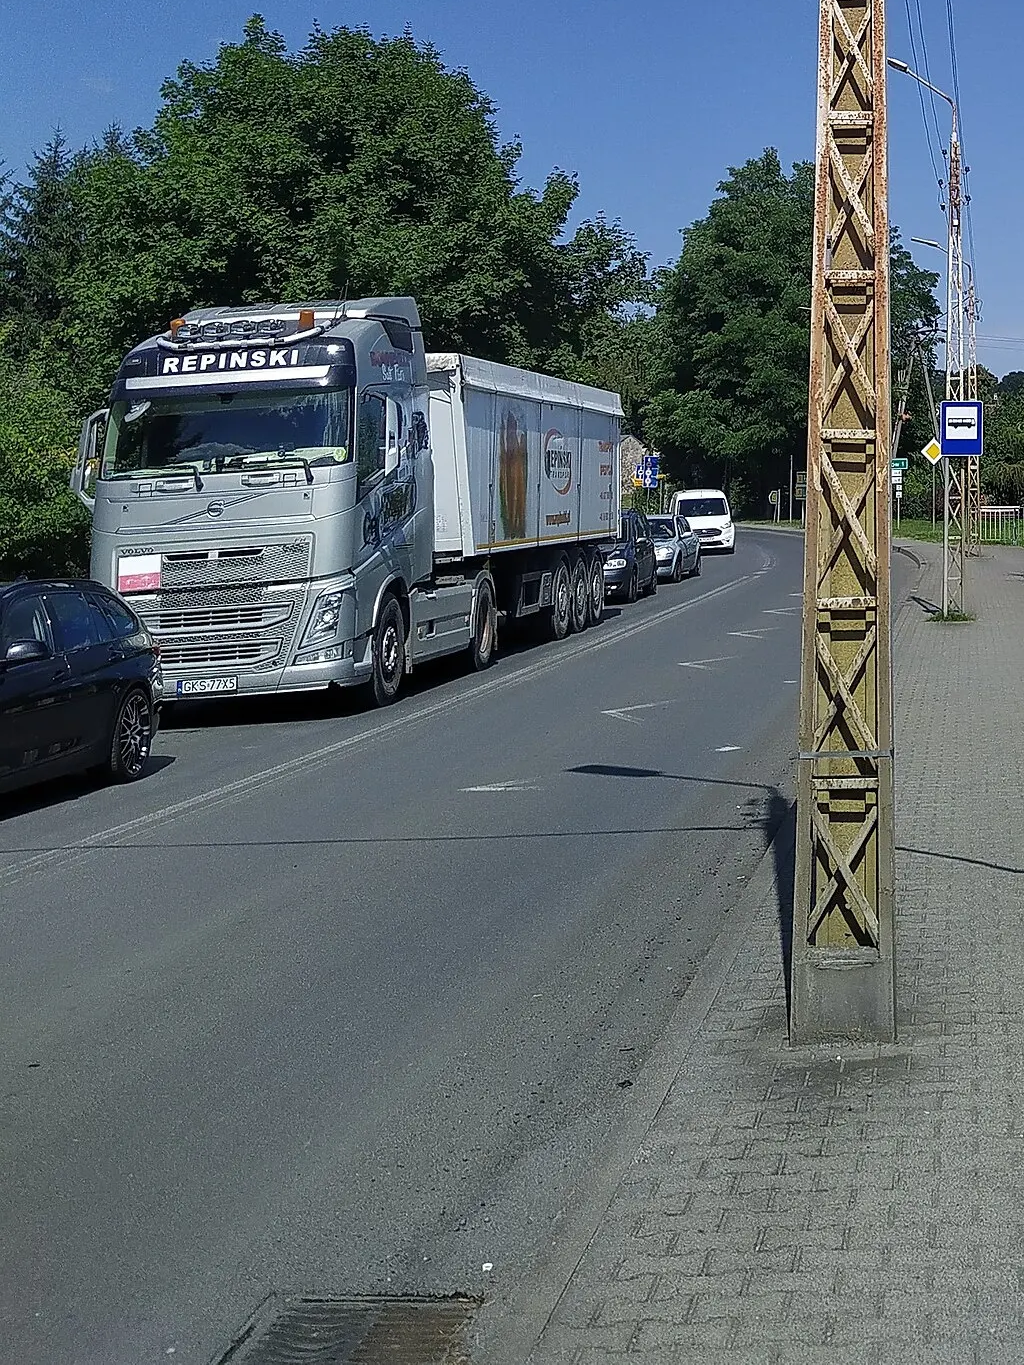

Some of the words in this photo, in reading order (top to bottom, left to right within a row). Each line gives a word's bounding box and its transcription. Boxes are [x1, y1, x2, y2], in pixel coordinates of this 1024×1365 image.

[162, 348, 299, 374] REPIŃSKI
[121, 547, 154, 555] VOLVO
[184, 680, 207, 692] GKS
[210, 678, 235, 690] 77X5
